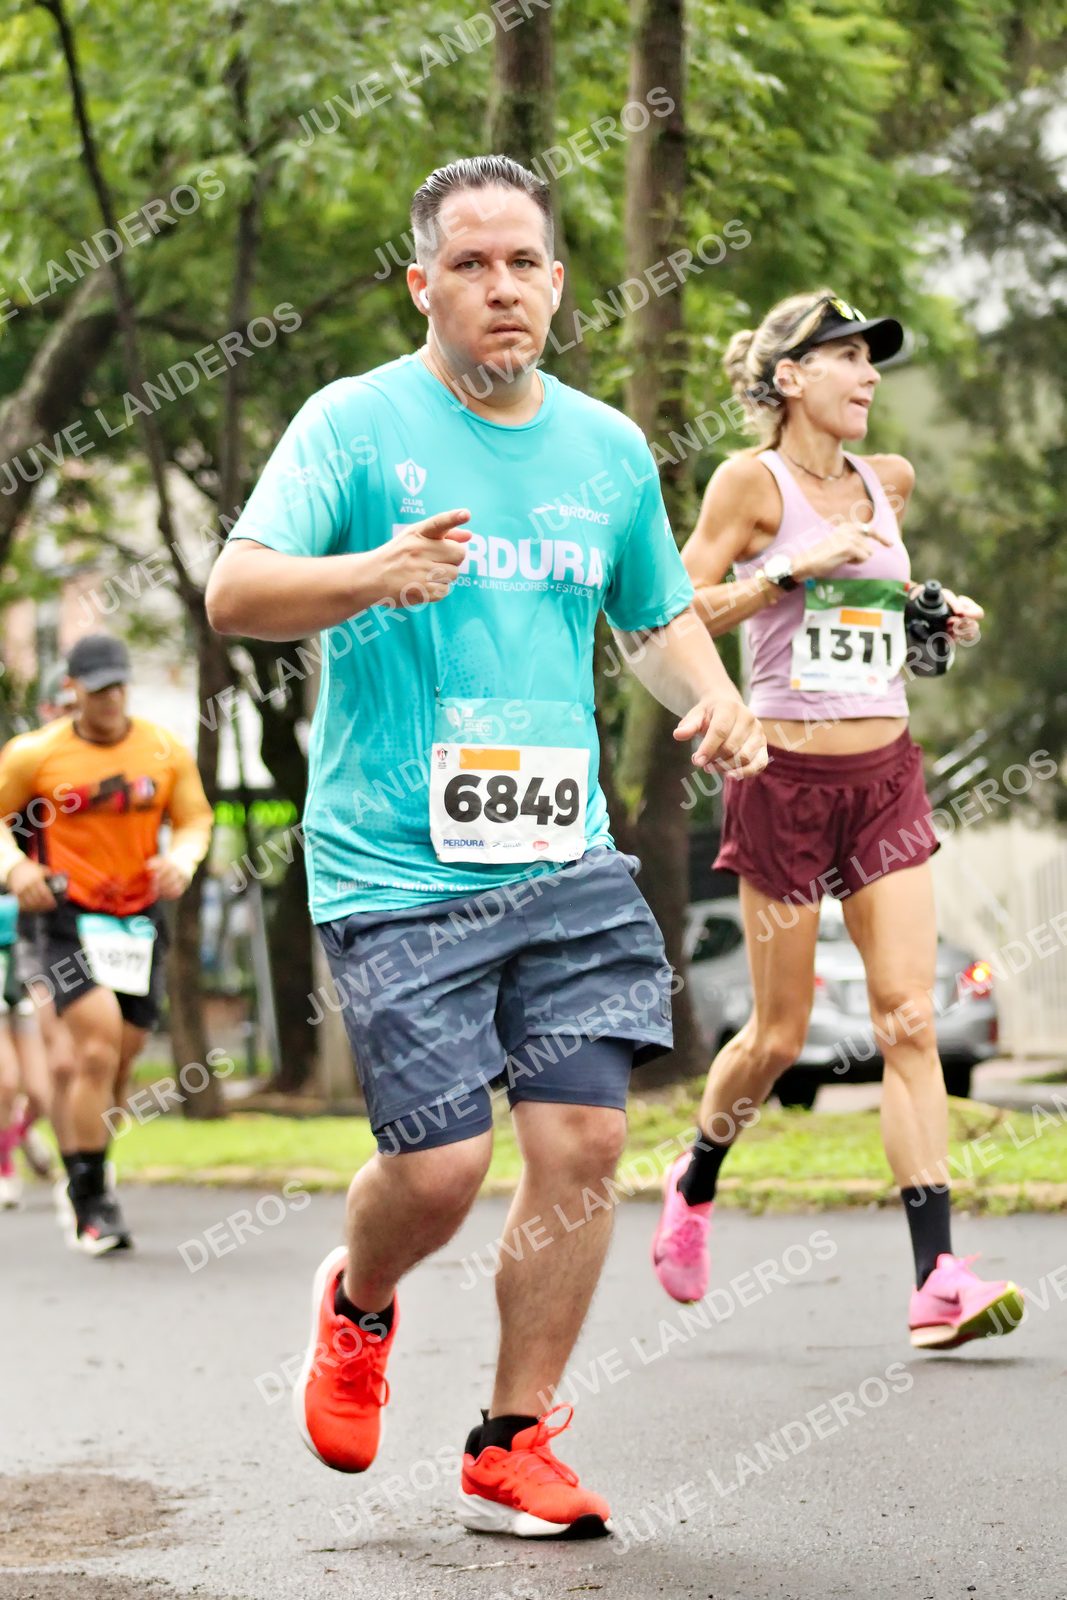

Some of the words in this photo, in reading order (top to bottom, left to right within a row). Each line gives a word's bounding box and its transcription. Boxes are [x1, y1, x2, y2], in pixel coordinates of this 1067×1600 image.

[402, 497, 423, 507] CLUB
[400, 505, 426, 515] ATLAS
[559, 504, 609, 525] BROOKS
[393, 524, 605, 590] RDURA
[479, 580, 548, 592] JUNTEADORES
[443, 773, 580, 827] 6849
[442, 839, 485, 848] PERDURA
